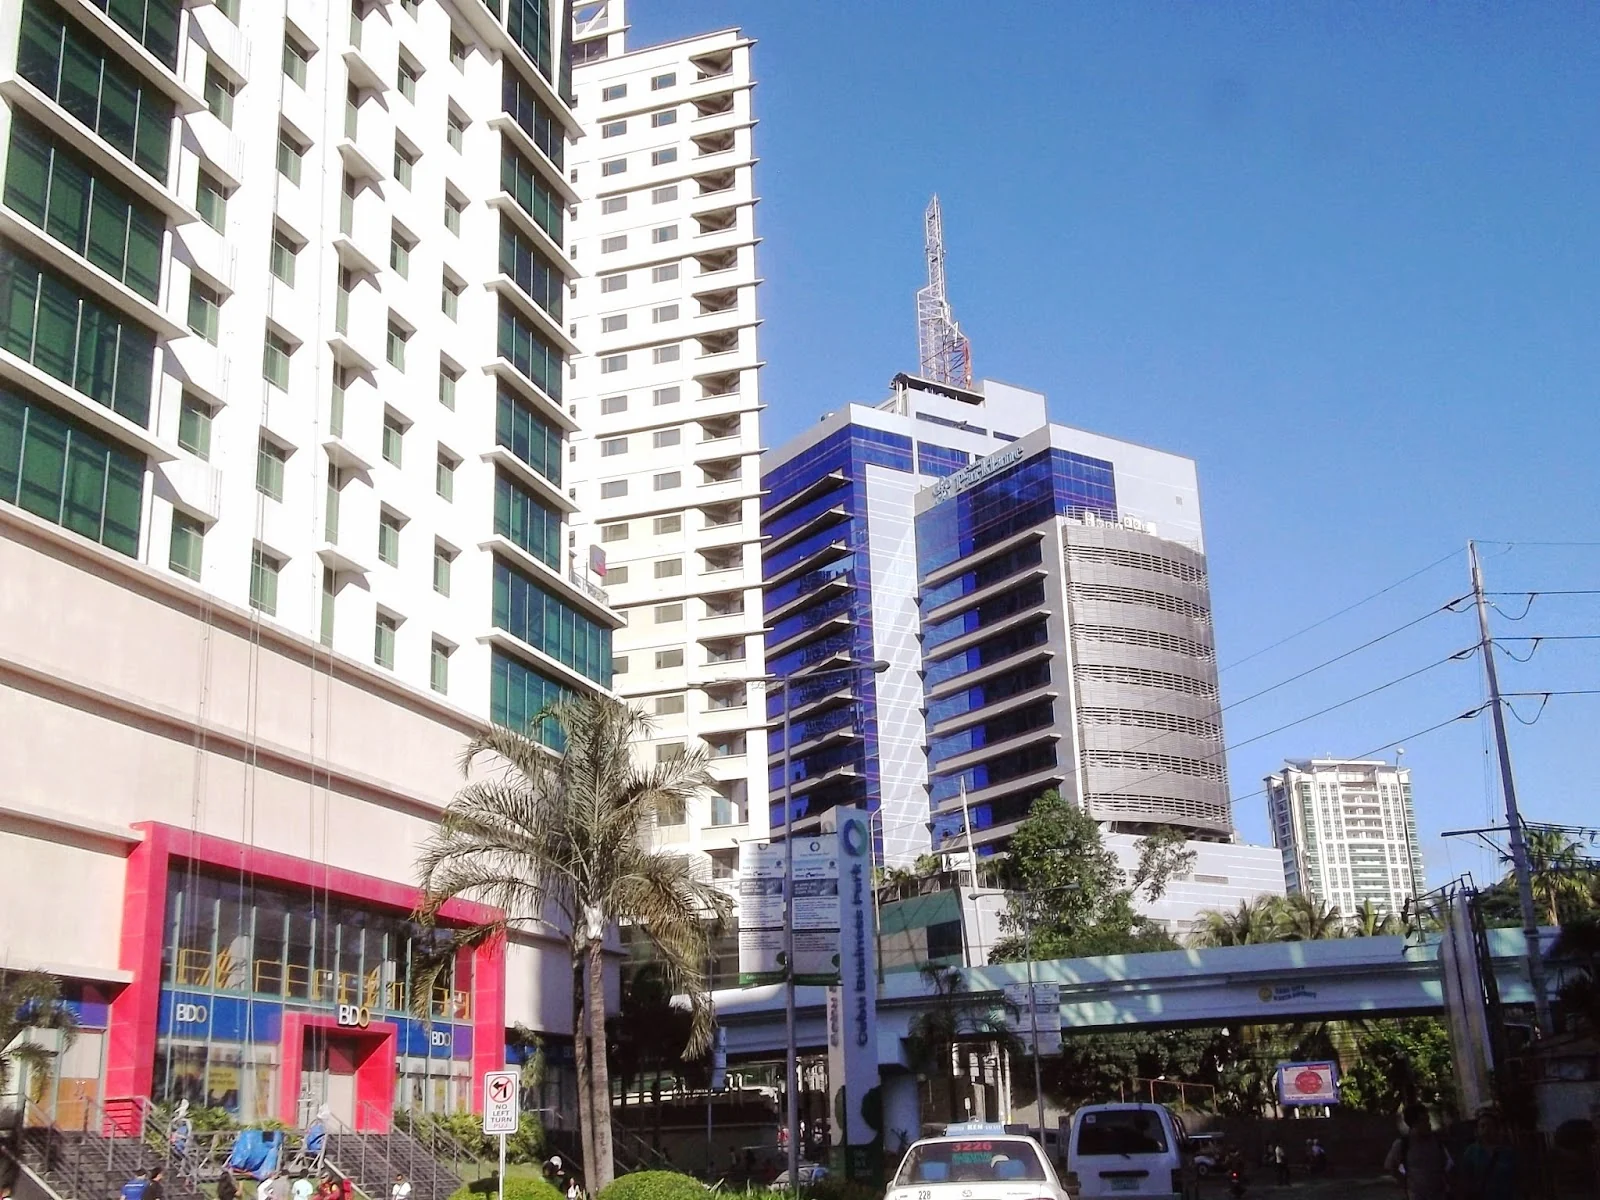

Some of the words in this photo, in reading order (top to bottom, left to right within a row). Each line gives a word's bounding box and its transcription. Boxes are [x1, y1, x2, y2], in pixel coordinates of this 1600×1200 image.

[850, 864, 863, 905] Park
[852, 909, 866, 992] Business
[176, 1003, 208, 1023] BDO
[338, 1004, 369, 1027] BDO
[855, 995, 868, 1047] Cebu
[431, 1031, 451, 1047] BDO
[952, 1142, 993, 1152] 3226
[918, 1190, 932, 1200] 228
